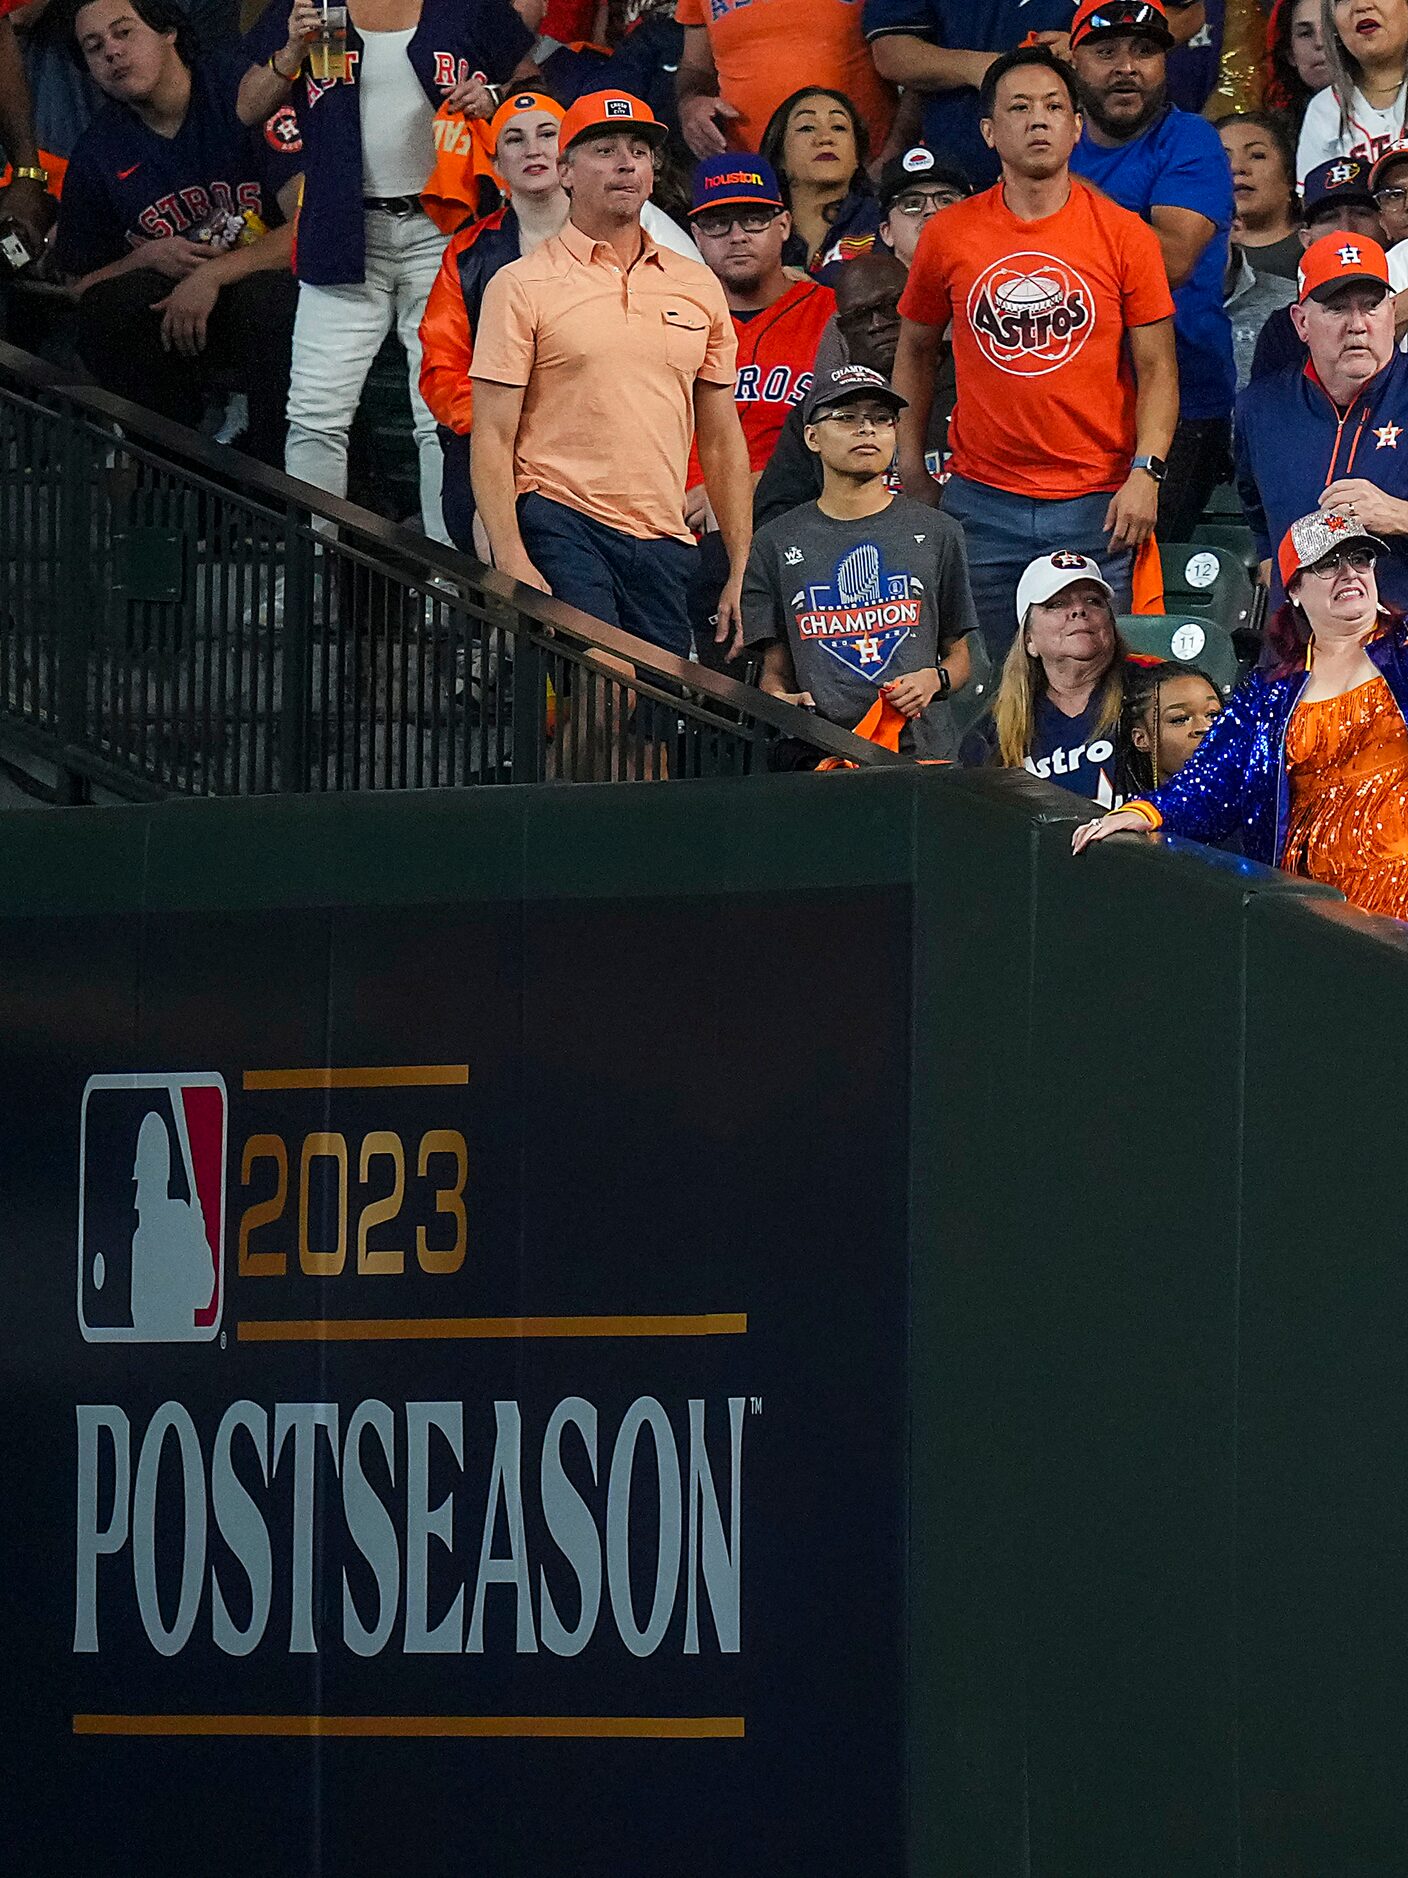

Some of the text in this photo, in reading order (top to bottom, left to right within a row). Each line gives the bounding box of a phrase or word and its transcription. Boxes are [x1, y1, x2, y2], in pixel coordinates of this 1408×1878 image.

[704, 171, 763, 190] houston
[1330, 163, 1351, 183] H
[1339, 247, 1362, 265] H
[973, 283, 1089, 351] Astros
[1377, 426, 1399, 446] H
[1193, 563, 1212, 578] 12
[818, 604, 857, 612] WORLD
[800, 602, 918, 636] CHAMPIONS
[855, 637, 882, 664] H
[1179, 636, 1196, 650] 11
[237, 1130, 469, 1276] 2023
[73, 1396, 746, 1658] POSTSEASON
